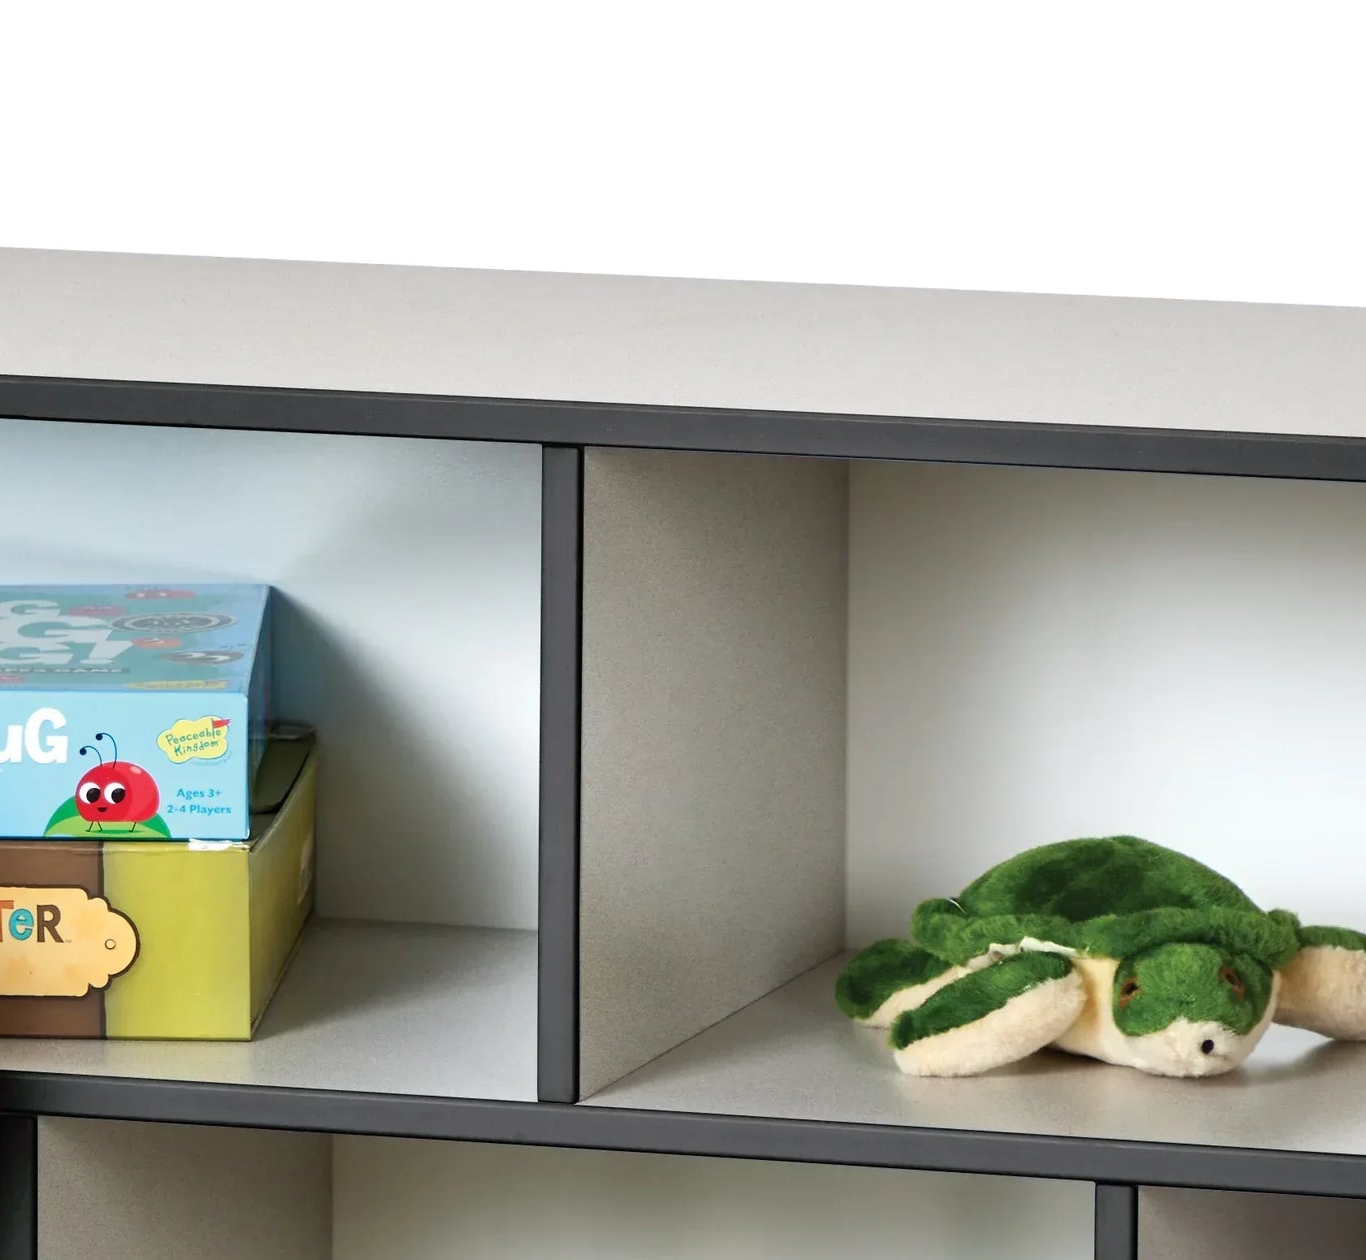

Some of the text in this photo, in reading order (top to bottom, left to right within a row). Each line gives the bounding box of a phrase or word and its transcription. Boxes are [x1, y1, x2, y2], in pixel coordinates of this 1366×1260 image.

[165, 728, 223, 746] Peaceable
[174, 740, 220, 757] Kingdom
[176, 788, 222, 801] Ages 3+
[167, 804, 232, 816] 2-4 Players
